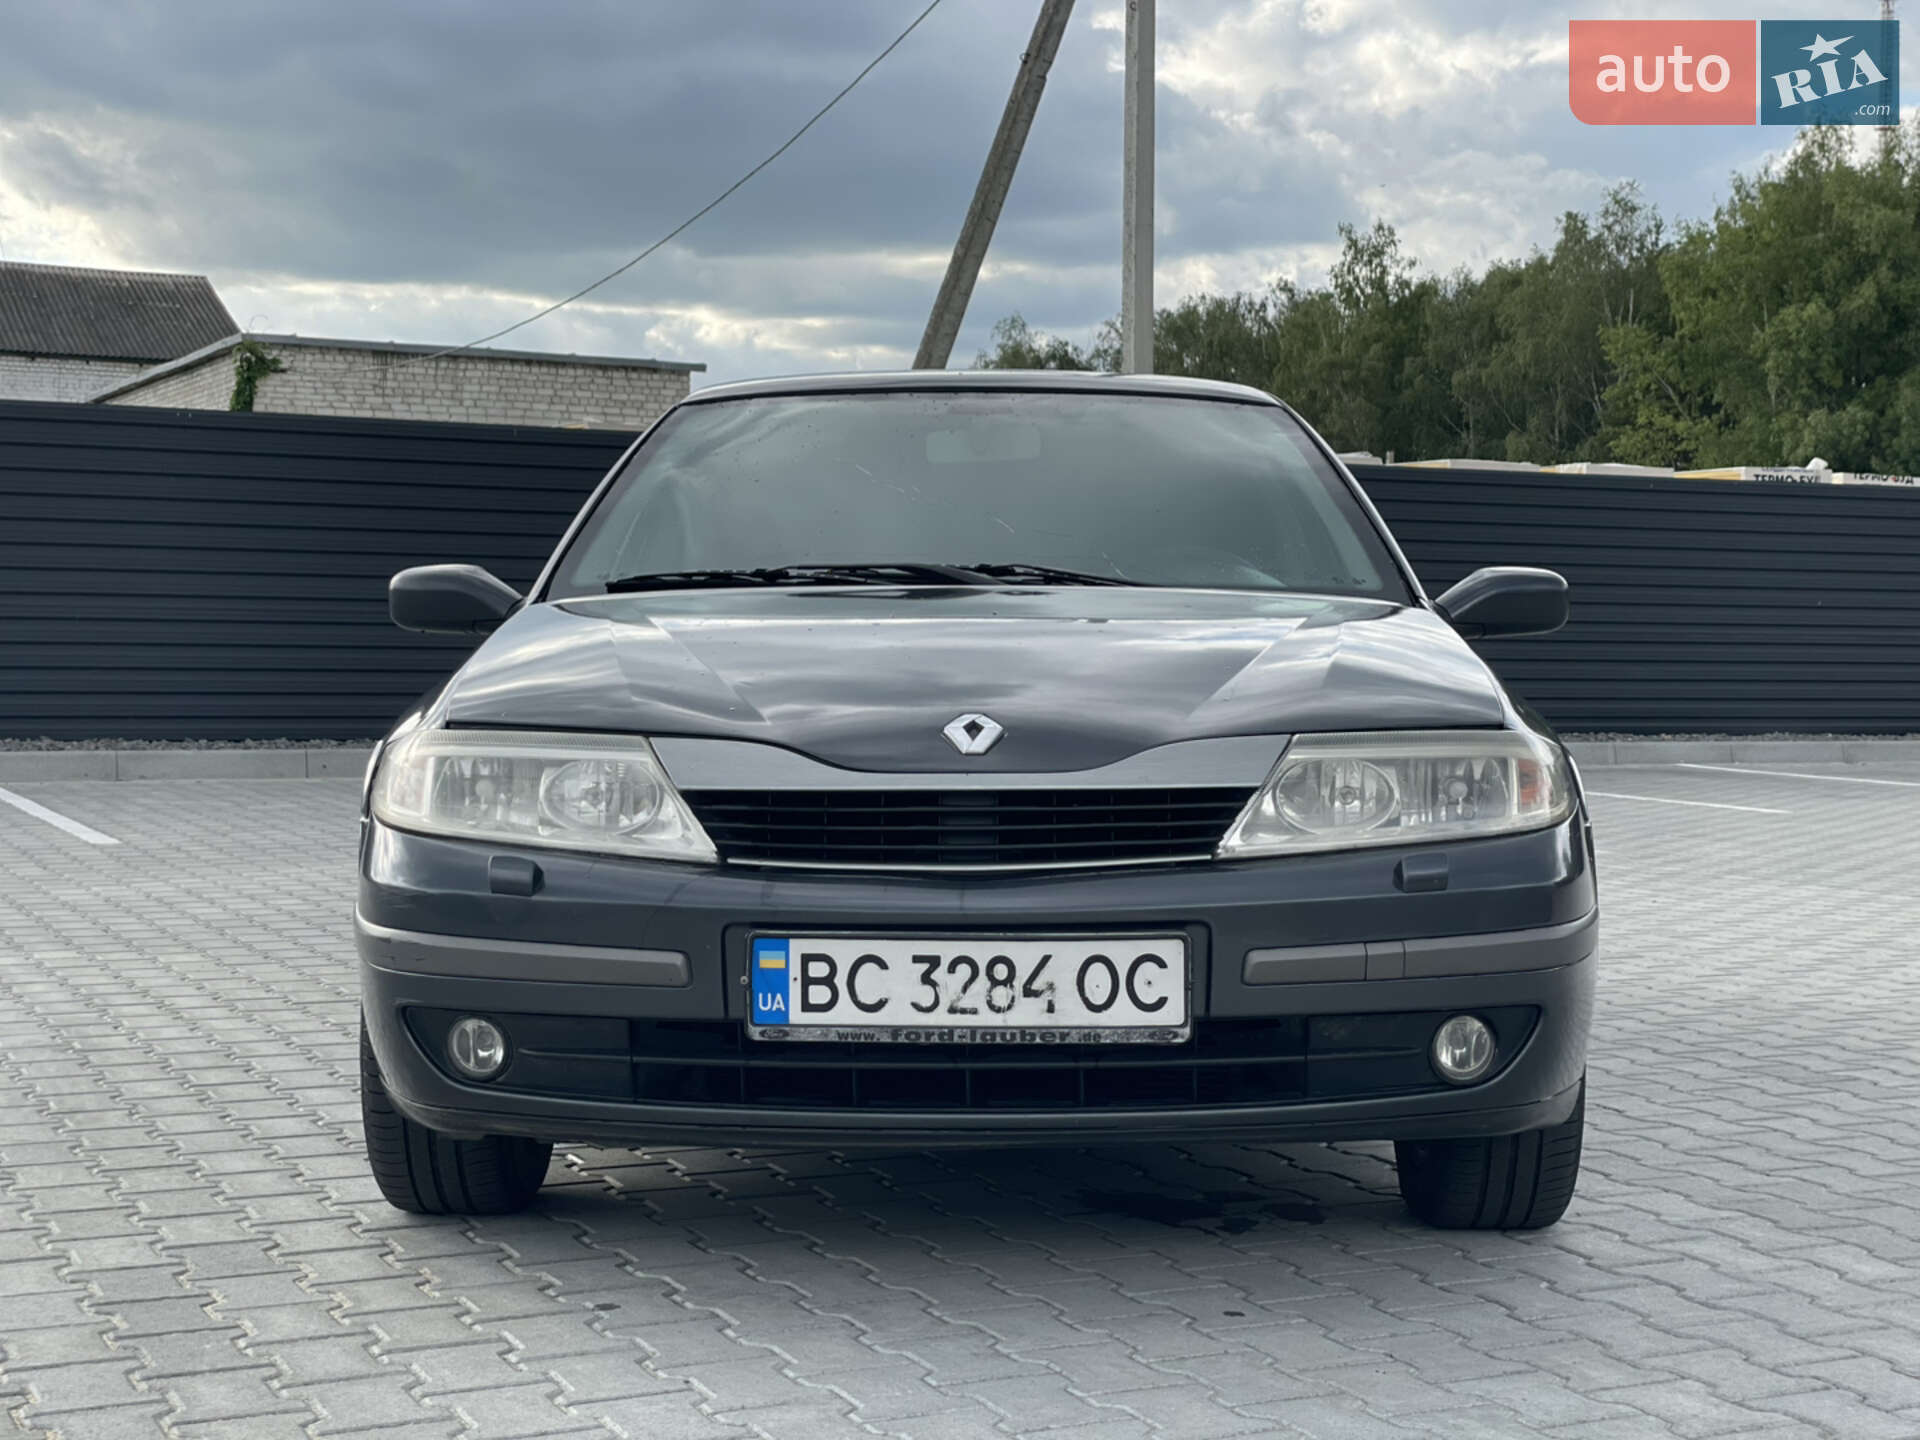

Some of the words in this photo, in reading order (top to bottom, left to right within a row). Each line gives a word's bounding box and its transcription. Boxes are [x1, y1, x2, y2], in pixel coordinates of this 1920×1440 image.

[758, 994, 785, 1011] UA
[800, 953, 889, 1013] BC
[910, 954, 1057, 1014] 3284
[1075, 953, 1169, 1013] OC
